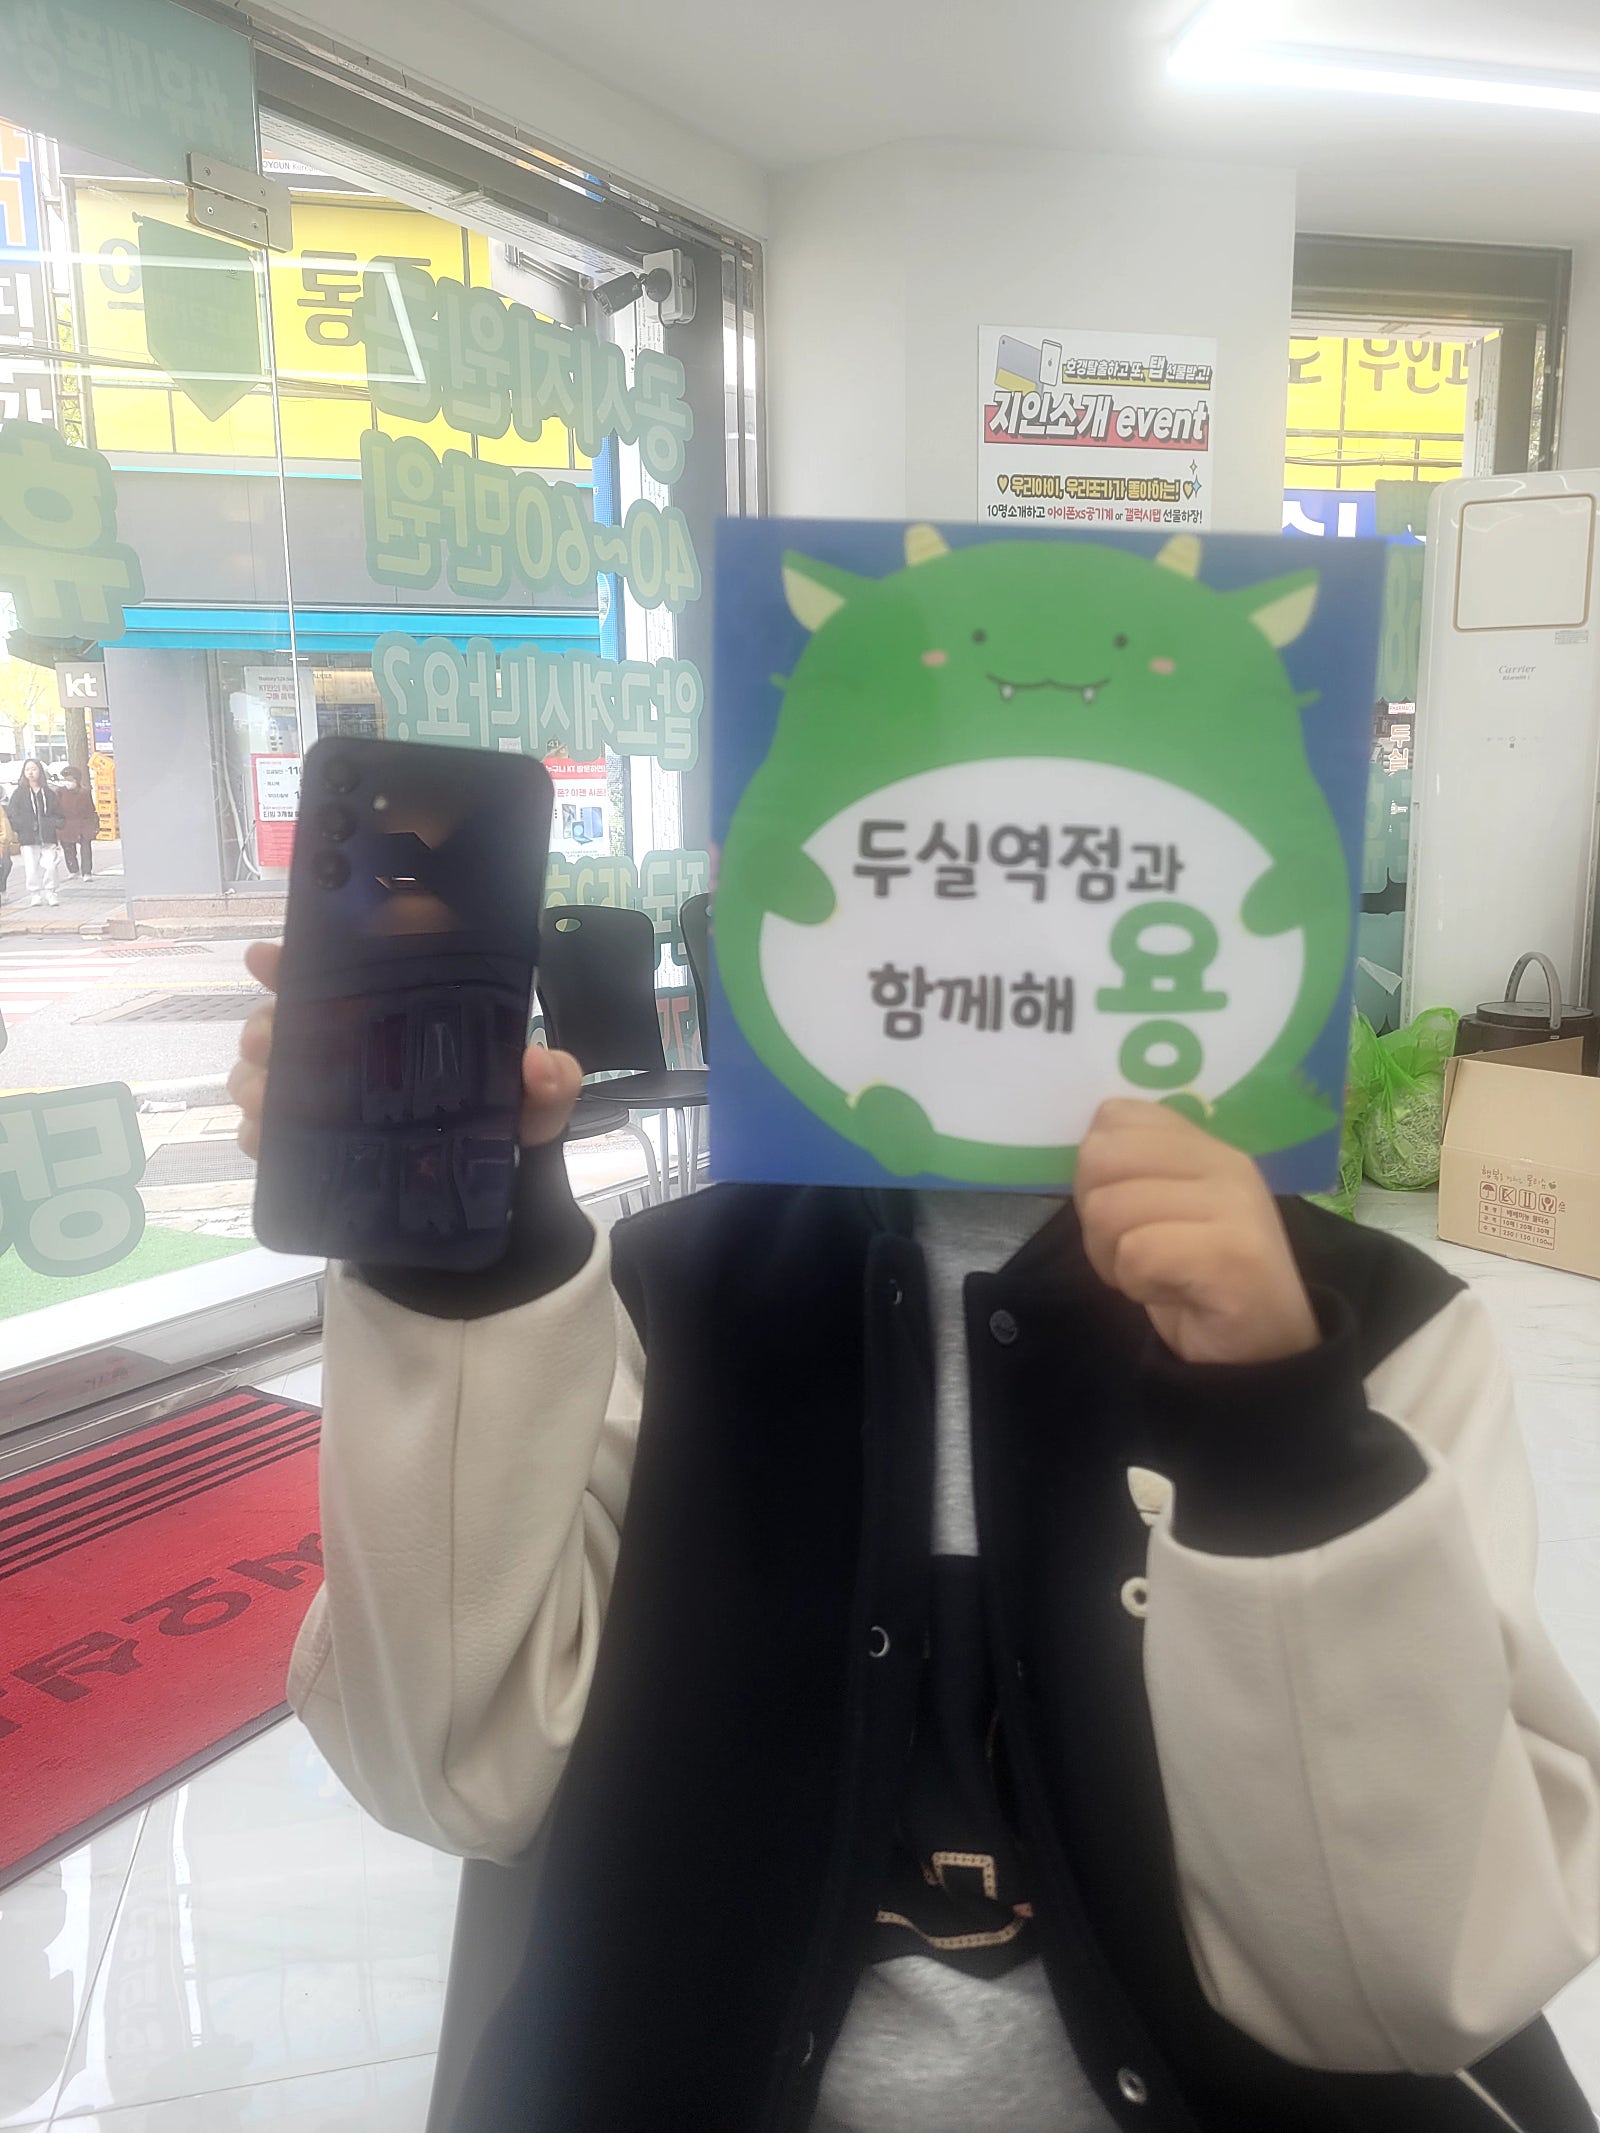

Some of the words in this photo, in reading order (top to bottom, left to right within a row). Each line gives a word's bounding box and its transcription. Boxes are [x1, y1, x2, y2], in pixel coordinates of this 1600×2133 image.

[1149, 355, 1168, 381] 탭
[989, 391, 1112, 441] 지인소개
[1115, 400, 1208, 443] event
[1011, 475, 1064, 499] 우리아이,
[987, 504, 1045, 519] 10명소개하고
[1125, 508, 1161, 522] 갤럭시탭
[1163, 509, 1203, 524] 선물하장!
[1498, 664, 1536, 675] Carrier
[65, 672, 97, 697] kt
[854, 819, 1185, 904] 두실역점과
